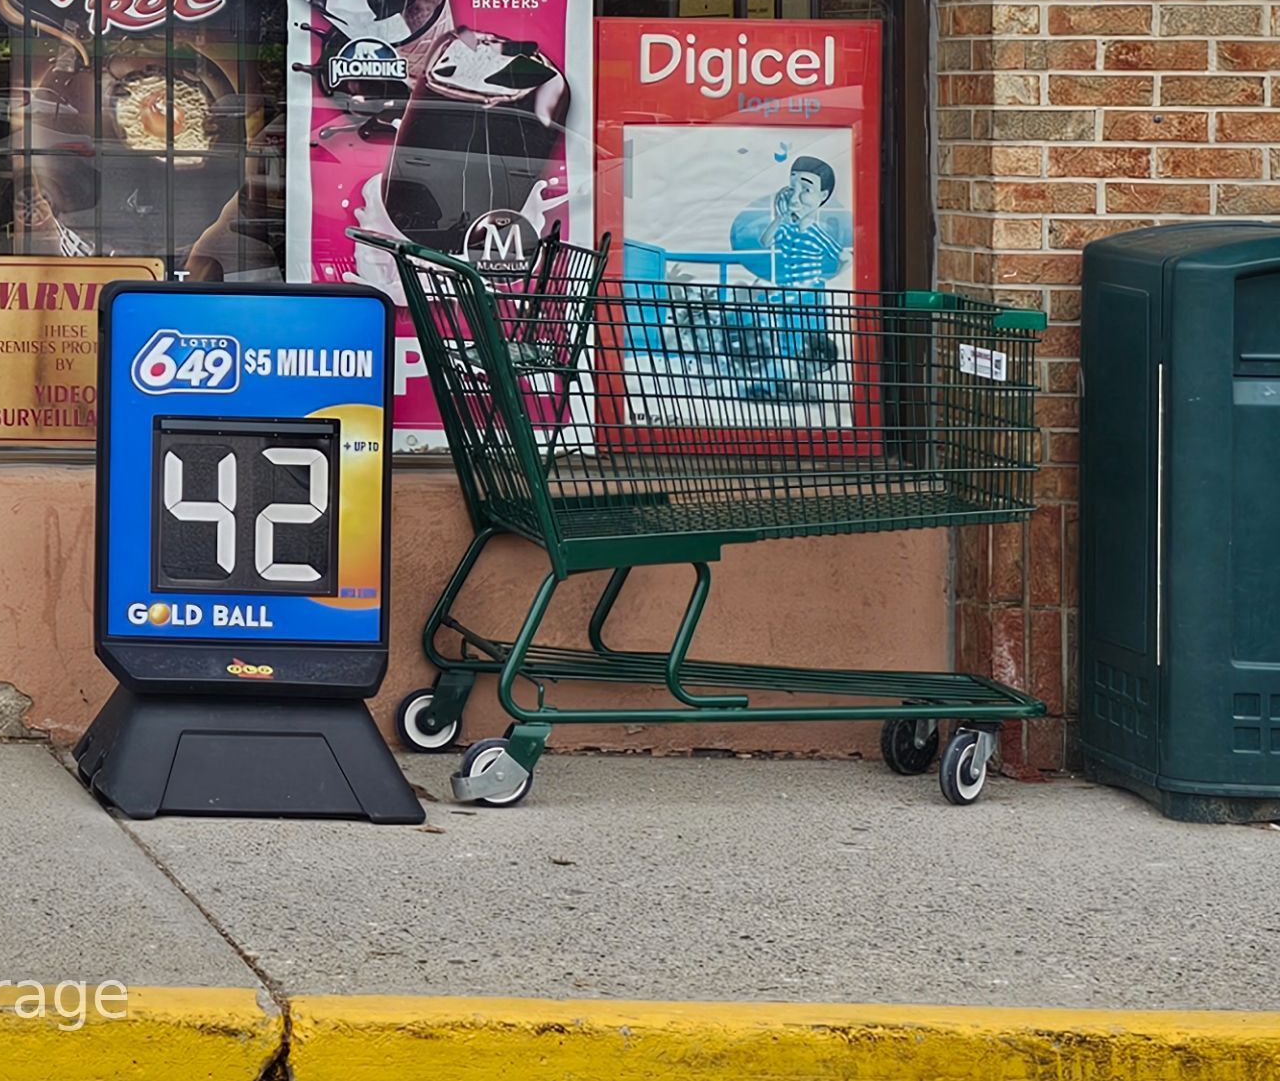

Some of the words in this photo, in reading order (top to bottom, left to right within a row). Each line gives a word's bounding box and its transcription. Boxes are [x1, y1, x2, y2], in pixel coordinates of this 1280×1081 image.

[330, 59, 407, 86] KLONDIKE
[640, 33, 836, 99] Digicel
[737, 93, 780, 117] top
[788, 96, 821, 119] up
[476, 260, 530, 271] MAGNUM
[43, 324, 88, 339] THESE
[180, 339, 228, 348] LOTTO
[55, 358, 75, 372] BY
[140, 336, 232, 387] 649
[244, 348, 272, 377] $5
[276, 350, 373, 379] MILLION
[354, 441, 366, 452] UP
[163, 447, 330, 583] 42
[213, 603, 273, 628] BALL
